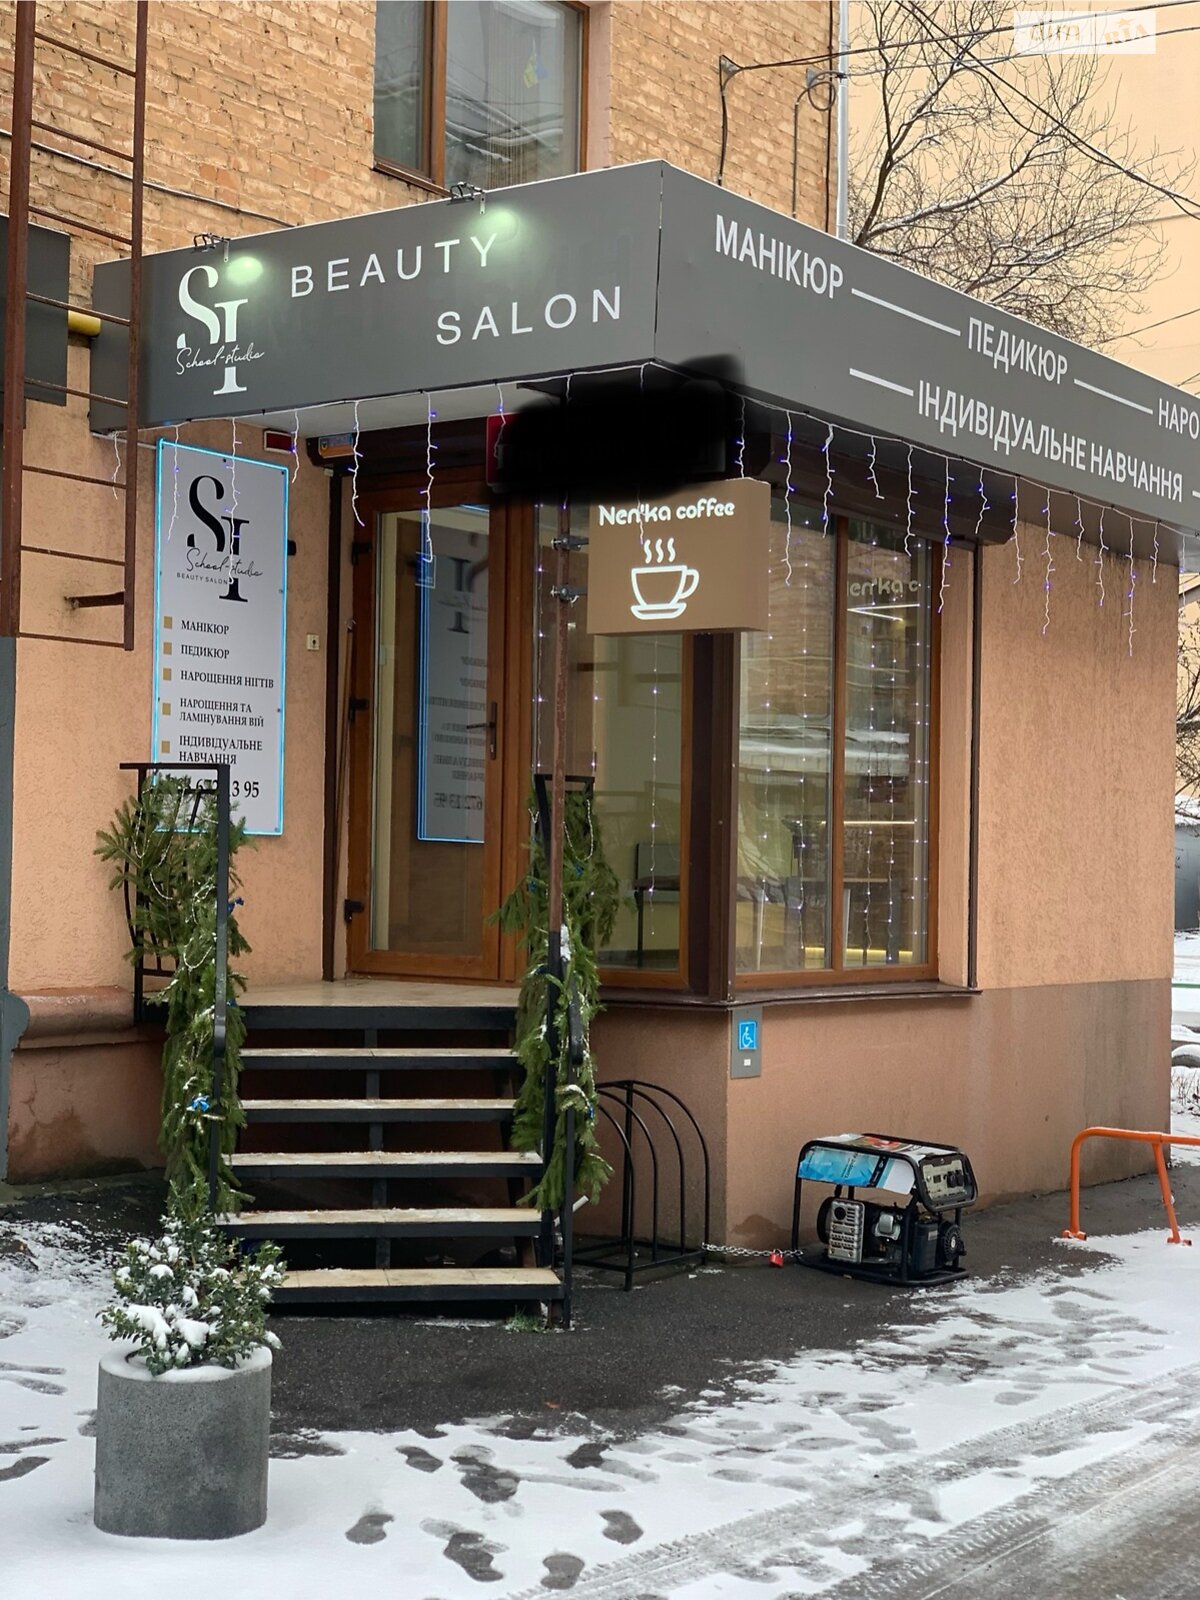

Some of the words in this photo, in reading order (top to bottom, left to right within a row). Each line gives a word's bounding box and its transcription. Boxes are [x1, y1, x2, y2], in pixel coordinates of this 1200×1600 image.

[290, 233, 498, 299] BEAUTY
[436, 286, 622, 346] SALON
[714, 213, 845, 299] МАНІКЮР
[967, 316, 1069, 385] ПЕДИКЮР
[1158, 397, 1200, 440] НАРО
[918, 379, 1087, 473] ІНДИВІДУАЛЬНЕ
[1089, 441, 1184, 503] НАВЧАННЯ
[675, 497, 736, 519] coffee
[176, 572, 203, 582] BEAUTY
[205, 576, 228, 585] SALON
[180, 619, 230, 636] МАНІКЮР
[180, 644, 230, 660] ПЕДИКЮР
[180, 670, 242, 686] НАРОЩЕННЯ
[244, 677, 274, 689] НІГТІВ
[179, 698, 239, 712] НАРОЩЕННЯ
[240, 703, 252, 713] ТА
[179, 711, 247, 726] ЛАМІНУВАННЯ
[248, 715, 264, 728] ВІЙ
[179, 735, 263, 751] ІНДИВІДУАЛЬНЕ
[178, 751, 237, 764] НАВЧАННЯ
[244, 781, 260, 798] 95
